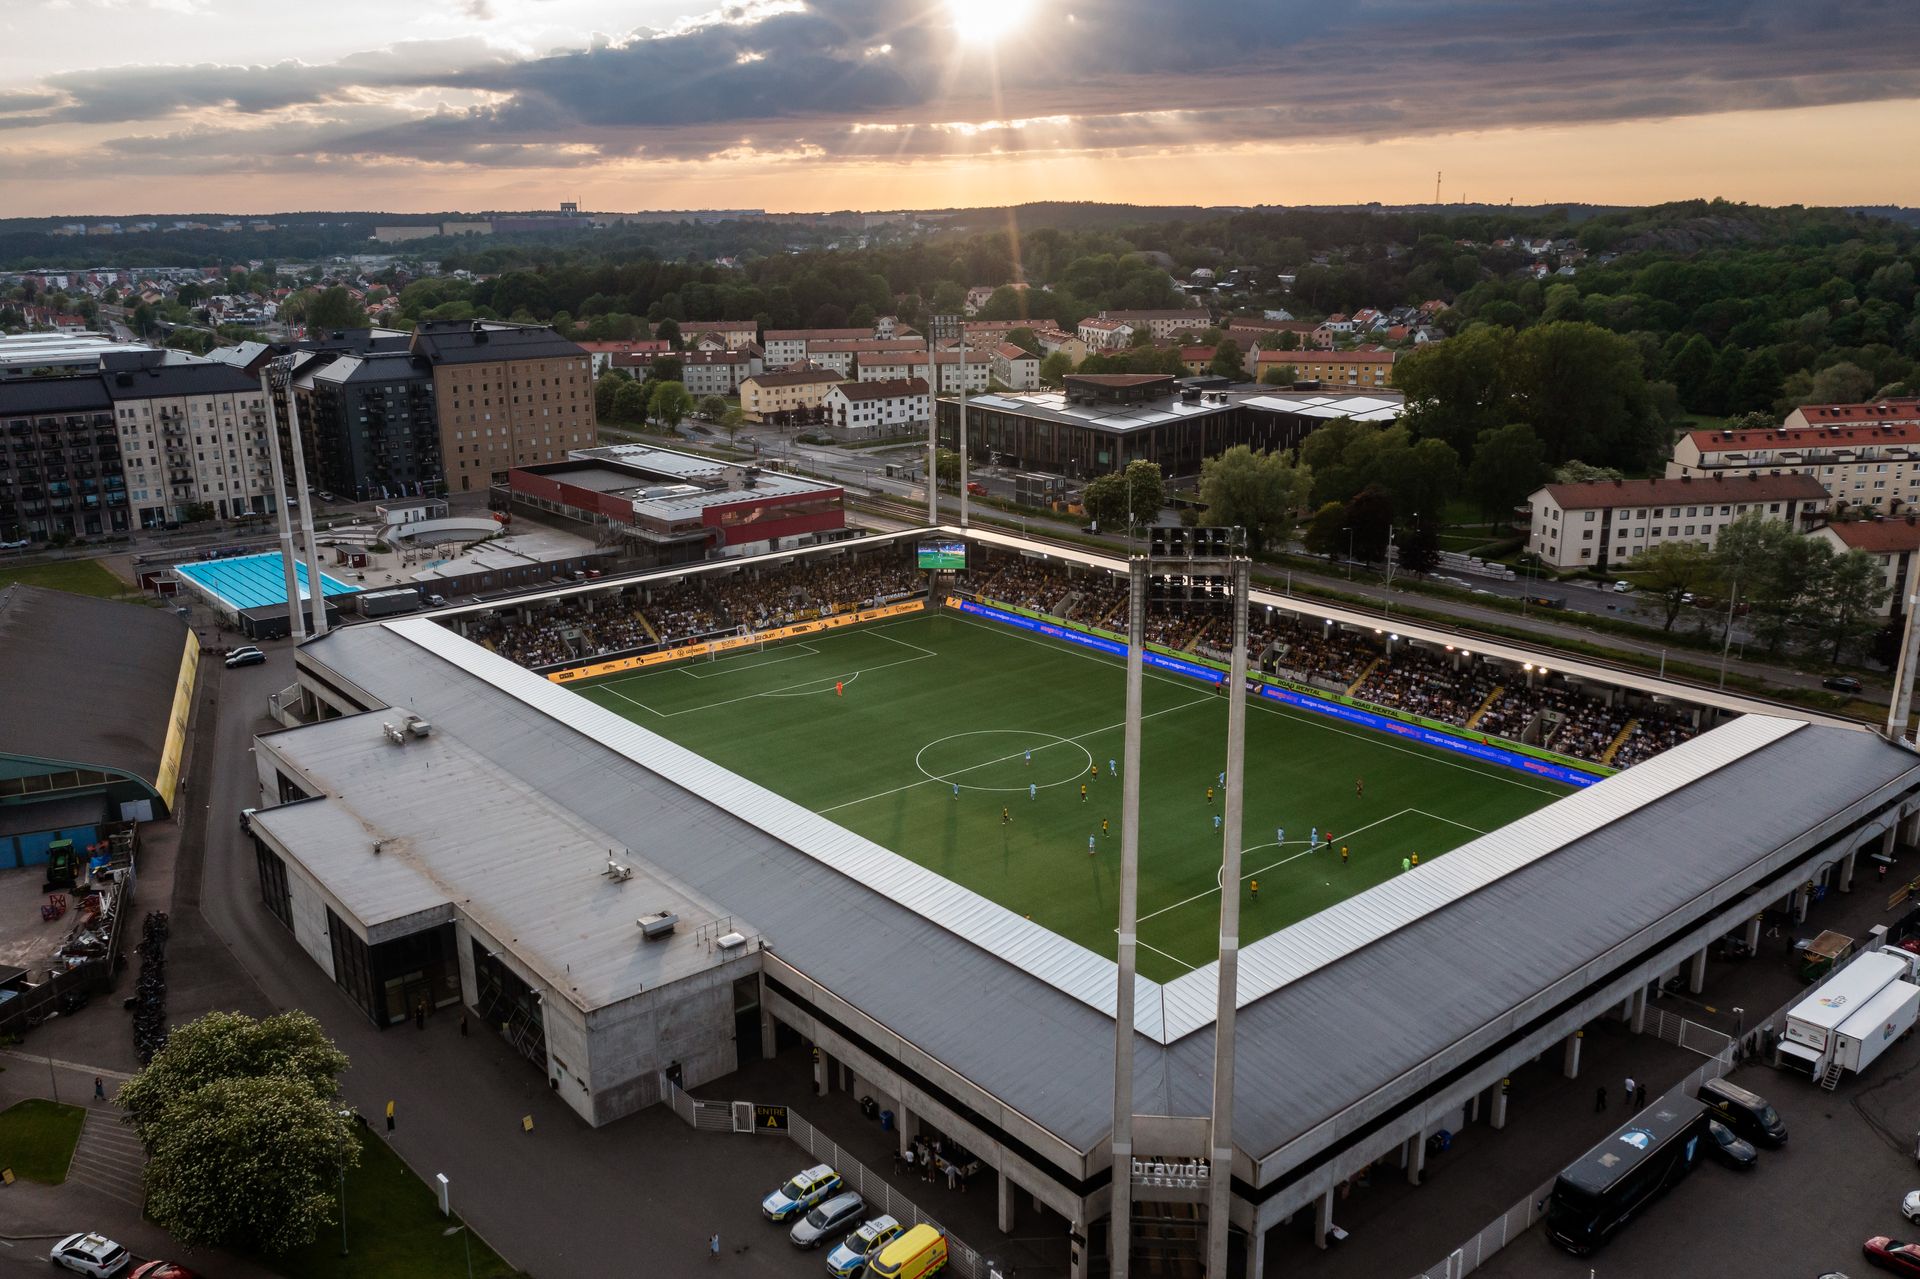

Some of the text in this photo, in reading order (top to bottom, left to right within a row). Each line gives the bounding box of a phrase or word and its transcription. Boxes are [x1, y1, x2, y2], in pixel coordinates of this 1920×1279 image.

[1277, 679, 1295, 690] ROAD
[1296, 685, 1321, 697] RENTAL
[1351, 700, 1371, 710] ROAD
[1372, 705, 1400, 718] RENTAL
[757, 1106, 785, 1116] ENTRÉ
[767, 1115, 778, 1127] A
[1131, 1157, 1209, 1178] bravida
[1141, 1177, 1199, 1188] ARENA
